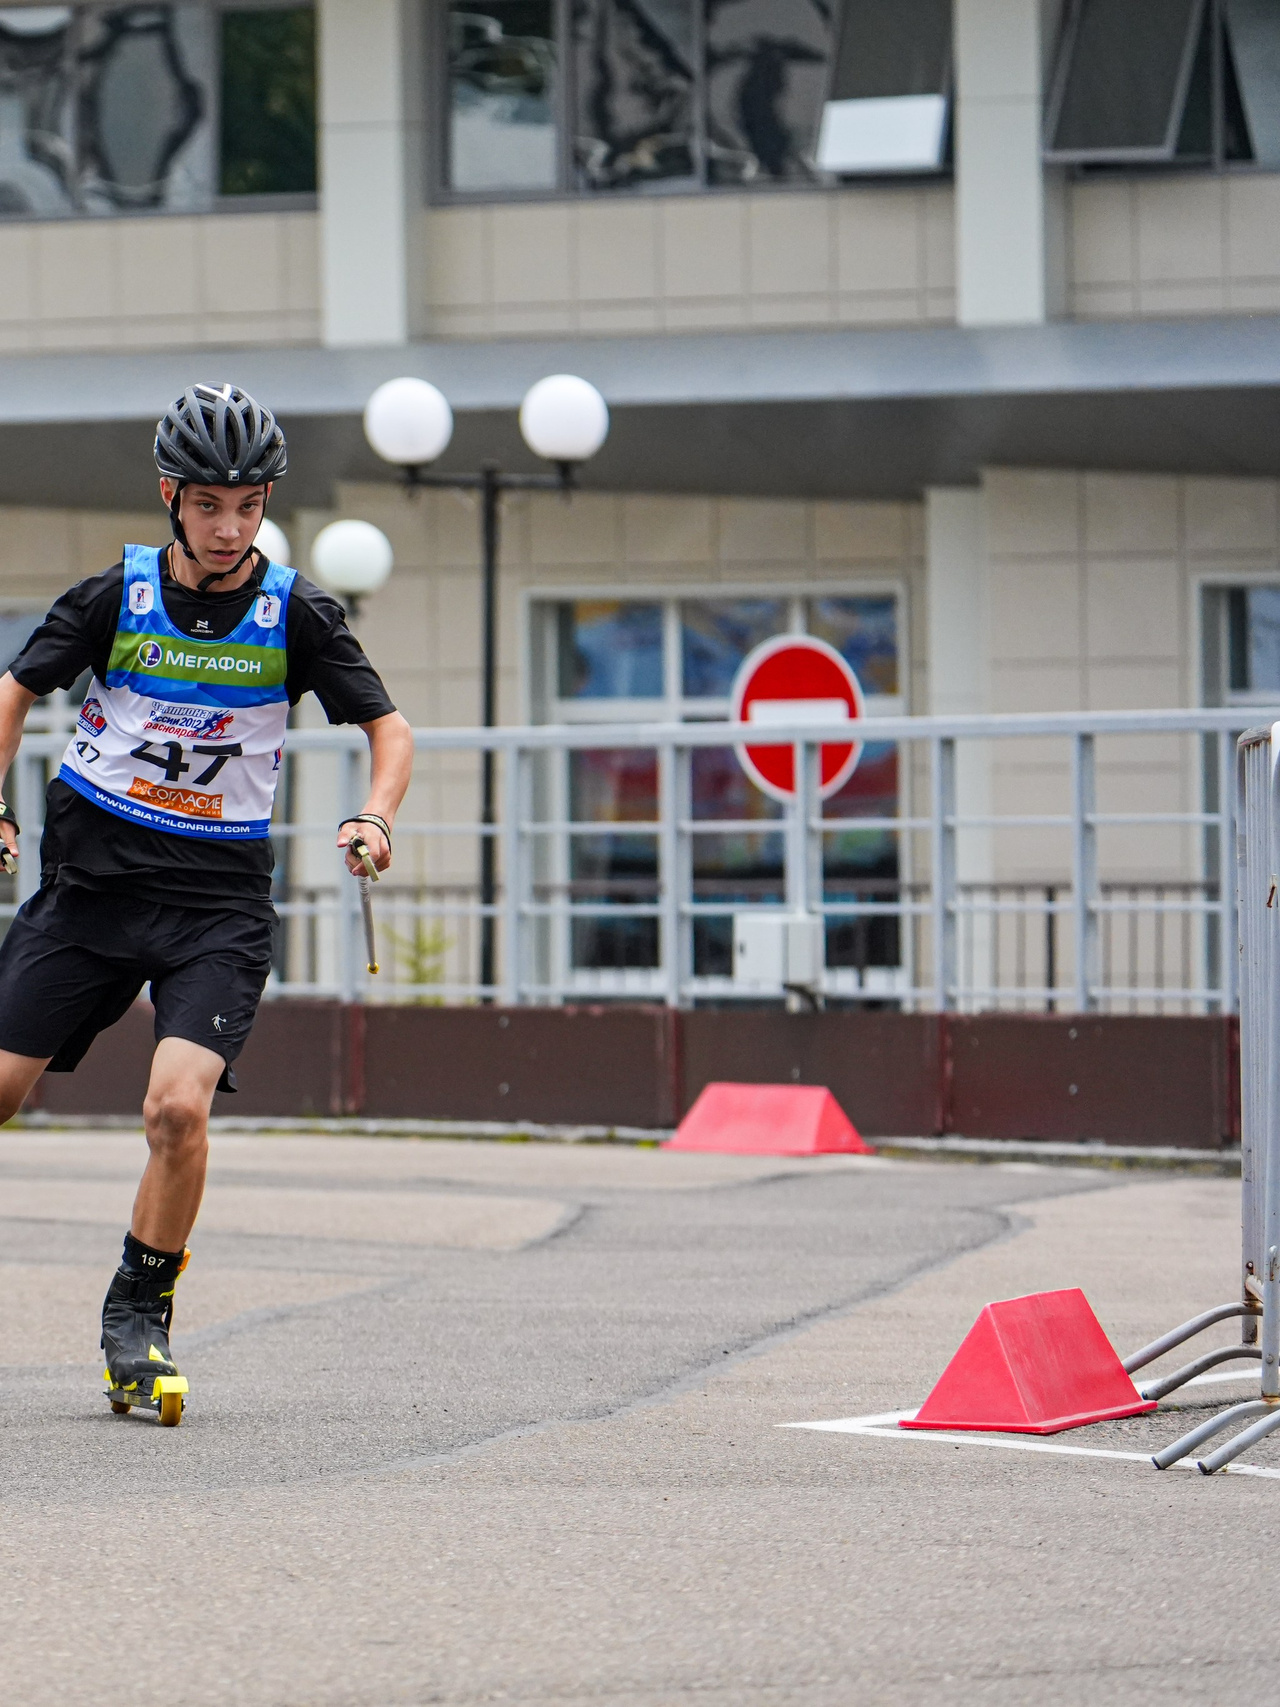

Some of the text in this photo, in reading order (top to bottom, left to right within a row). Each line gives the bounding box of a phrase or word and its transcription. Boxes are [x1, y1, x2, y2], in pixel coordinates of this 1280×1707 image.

[179, 716, 203, 729] 2012
[76, 740, 101, 764] 47
[130, 740, 243, 786] 47
[146, 786, 222, 811] СОГЛАСИЕ
[95, 791, 251, 834] WWW.BIATHLONRUS.COM
[141, 1253, 166, 1268] 197
